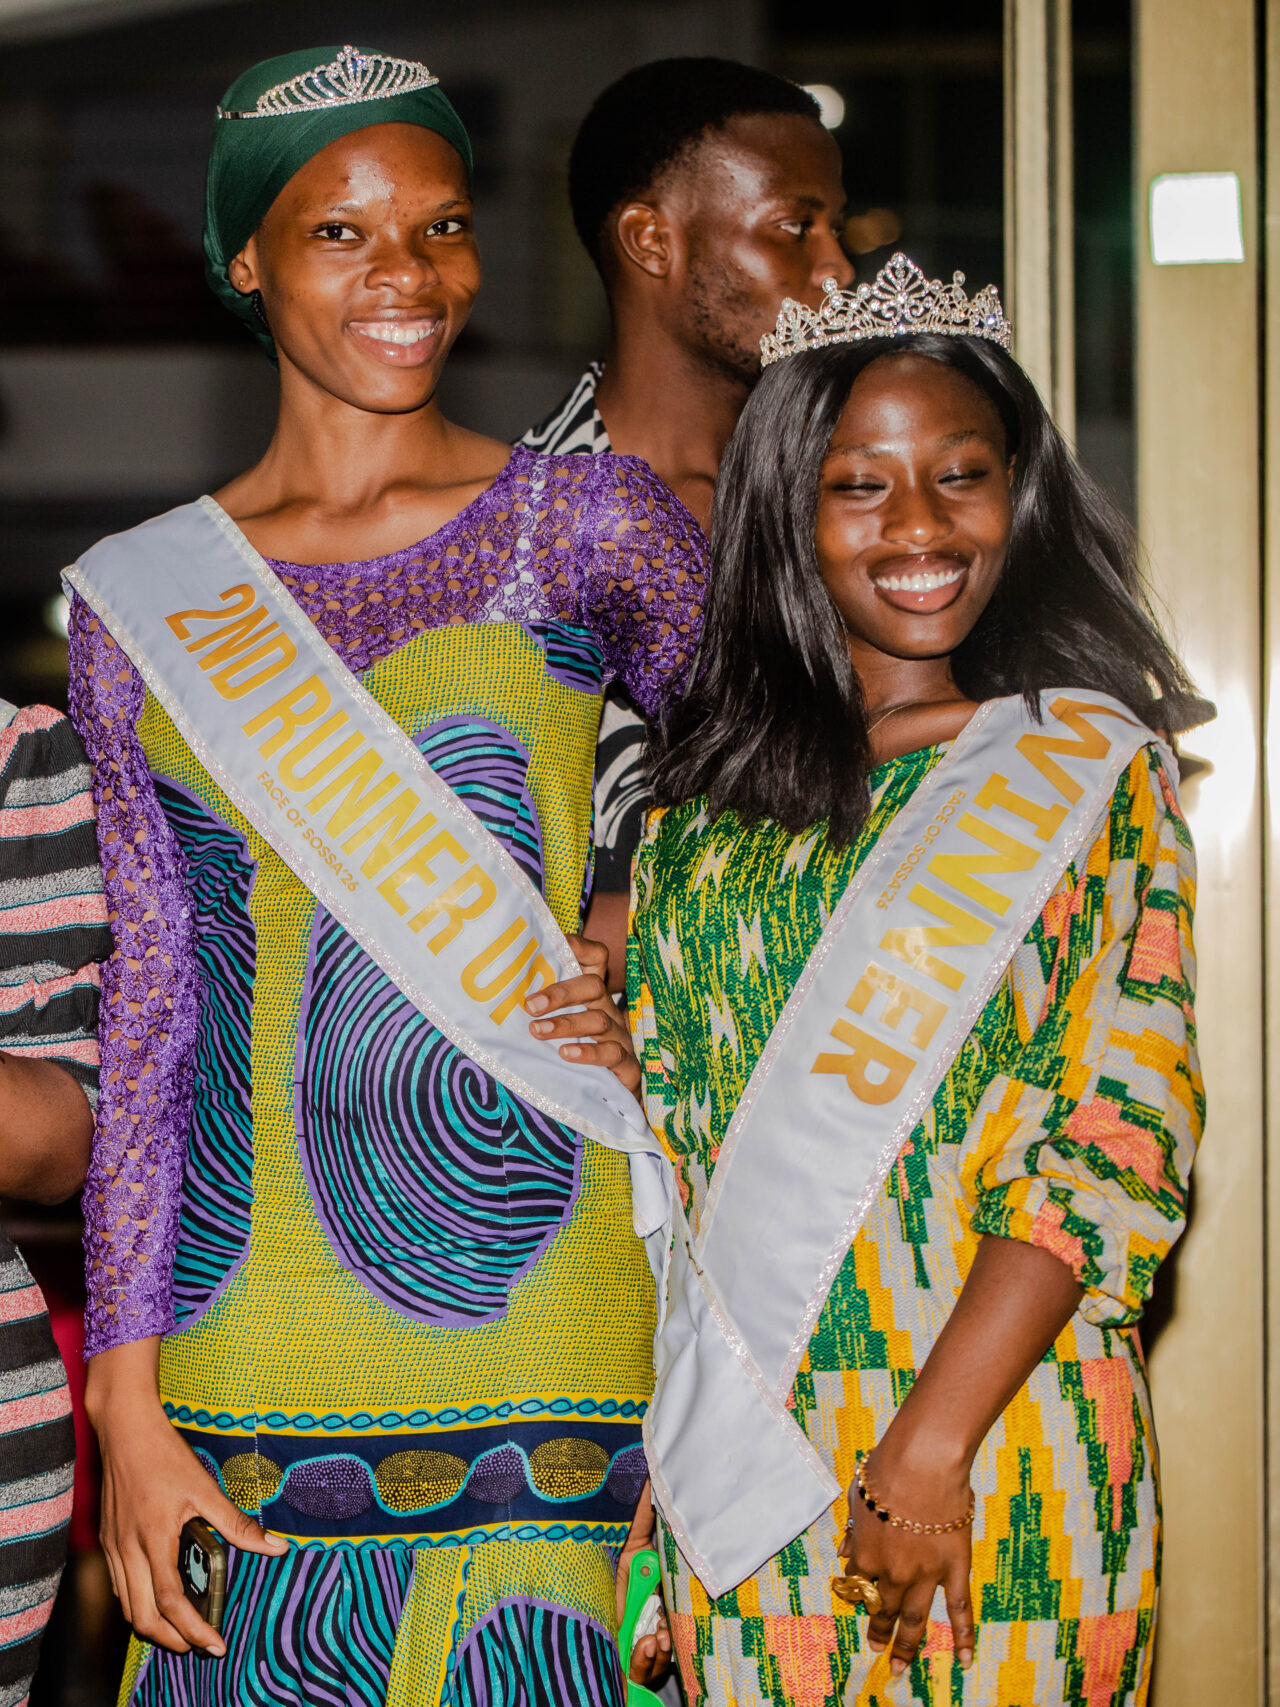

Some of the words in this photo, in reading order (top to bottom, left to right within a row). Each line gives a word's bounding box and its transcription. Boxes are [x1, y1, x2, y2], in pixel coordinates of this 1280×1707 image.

[164, 583, 298, 701] 2ND
[241, 674, 498, 957] RUNNER
[460, 915, 557, 1027] UP
[257, 770, 290, 810] FACE
[286, 808, 307, 828] OF
[302, 827, 360, 893] SOSSA'26
[922, 824, 941, 846] OF
[935, 787, 967, 825] FACE
[809, 696, 1143, 1106] WINNER
[875, 843, 927, 911] SOSSA'26
